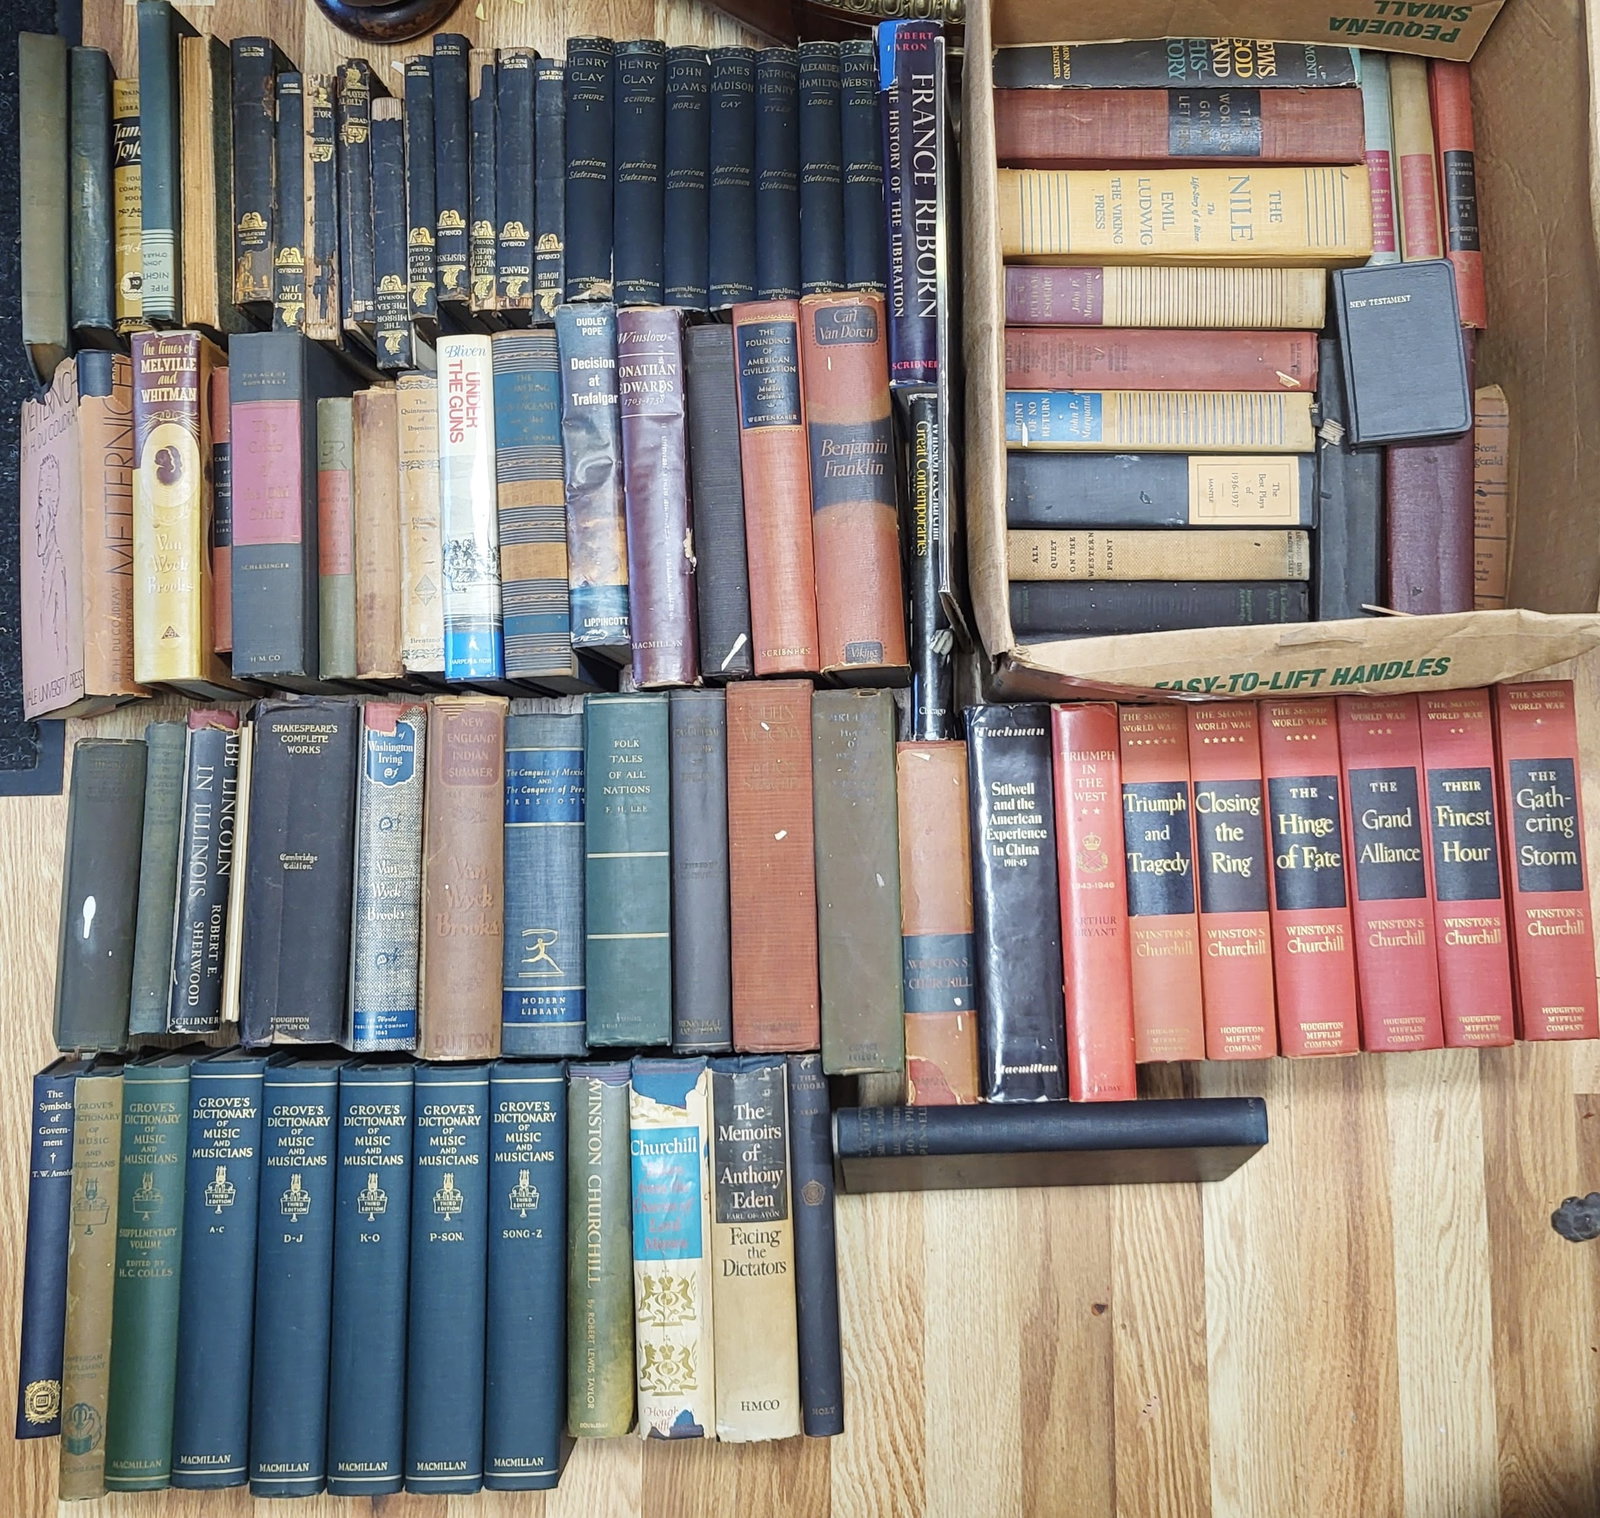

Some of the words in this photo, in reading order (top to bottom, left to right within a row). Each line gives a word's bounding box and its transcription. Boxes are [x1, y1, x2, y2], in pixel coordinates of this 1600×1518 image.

[1374, 0, 1472, 22] SMALL
[1328, 16, 1461, 43] PEQUEÑA
[568, 56, 609, 69] HENRY
[571, 72, 605, 82] CLAY
[670, 67, 702, 79] JOHN
[666, 83, 707, 94] ADAMS
[911, 73, 937, 186] FRANCE
[889, 106, 900, 170] HISTORY
[568, 158, 607, 168] American
[568, 171, 607, 180] Statesmen
[891, 176, 900, 195] OF
[1112, 178, 1122, 200] THE
[891, 200, 901, 228] THE
[1095, 195, 1105, 230] PRESS
[1138, 178, 1153, 246] LUDWIG
[1161, 192, 1175, 231] EMIL
[1229, 175, 1254, 242] NILE
[1269, 191, 1283, 223] THE
[1114, 204, 1124, 245] VIKING
[914, 198, 937, 318] REBORN
[142, 272, 169, 280] NIGHT
[891, 233, 904, 318] LIBERATION
[279, 292, 302, 301] LORD
[1350, 299, 1366, 308] NEW
[1369, 295, 1412, 306] TESTAMENT
[576, 317, 608, 327] DUDLEY
[833, 310, 857, 323] Carl
[582, 327, 603, 336] POPE
[618, 330, 667, 344] Winslow
[819, 327, 838, 340] Van
[840, 326, 874, 339] Doren
[745, 337, 791, 347] FOUNDING
[445, 345, 486, 358] Bliven
[141, 358, 197, 373] MELVILLE
[571, 356, 615, 370] Decision
[747, 356, 790, 366] AMERICAN
[448, 359, 463, 392] THE
[742, 366, 797, 376] CIVILIZATION
[158, 373, 178, 385] and
[589, 375, 600, 387] at
[141, 388, 197, 404] WHITMAN
[465, 371, 478, 428] UNDER
[572, 392, 618, 406] Trafalgar
[449, 396, 464, 443] GUNS
[915, 420, 929, 457] Great
[821, 438, 888, 460] Benjamin
[824, 459, 884, 477] Franklin
[1258, 473, 1266, 487] Best
[1231, 471, 1239, 508] 1936-1937
[1258, 489, 1266, 509] Plays
[915, 459, 928, 557] Contemporaries
[1050, 540, 1058, 569] QUIET
[1069, 558, 1076, 573] ON
[584, 617, 629, 627] LIPPINCOTT
[631, 640, 683, 650] MACMILLAN
[1330, 656, 1451, 686] HANDLES
[272, 724, 338, 733] SHAKESPEARE'S
[1272, 719, 1304, 728] WORLD
[1307, 718, 1328, 726] WAR
[281, 735, 329, 743] COMPLETE
[975, 726, 1045, 738] Tuchman
[223, 731, 240, 768] ABE
[287, 746, 321, 754] WORKS
[368, 741, 414, 752] Washington
[613, 739, 640, 748] FOLK
[378, 753, 403, 765] Irving
[452, 752, 489, 761] INDIAN
[609, 755, 643, 763] TALES
[449, 767, 493, 778] SUMMER
[609, 771, 621, 779] OF
[626, 771, 646, 779] ALL
[1082, 764, 1096, 774] IN
[196, 765, 213, 791] IN
[1528, 772, 1557, 781] THE
[603, 785, 651, 795] NATIONS
[992, 782, 1035, 796] Stilwell
[1076, 779, 1104, 789] THE
[1370, 782, 1397, 792] THE
[1442, 781, 1482, 791] THEIR
[1074, 792, 1107, 801] WEST
[1290, 788, 1318, 798] THE
[1516, 786, 1572, 811] Gath-
[993, 799, 1015, 811] and
[1017, 799, 1035, 809] the
[1123, 792, 1186, 815] Triumph
[1195, 792, 1261, 815] Closing
[989, 814, 1042, 825] American
[1362, 807, 1412, 831] Grand
[1435, 806, 1492, 827] Finest
[216, 777, 236, 877] LINCOLN
[1215, 823, 1244, 842] the
[1279, 814, 1334, 837] Hinge
[1525, 814, 1575, 838] ering
[987, 828, 1047, 842] Experience
[1144, 825, 1170, 841] and
[189, 802, 212, 898] ILLINOIS
[993, 844, 1004, 856] in
[1006, 843, 1040, 856] China
[1360, 843, 1421, 864] Alliance
[1442, 841, 1491, 863] Hour
[1520, 845, 1578, 867] Storm
[1128, 852, 1190, 876] Tragedy
[1277, 845, 1299, 869] of
[1302, 847, 1341, 869] Fate
[1211, 852, 1253, 877] Ring
[1527, 920, 1584, 937] Churchill
[1208, 940, 1266, 957] Churchill
[1287, 936, 1345, 954] Churchill
[187, 921, 205, 1006] SHERWOOD
[522, 997, 566, 1005] MODERN
[1300, 1022, 1344, 1031] HOUGHTON
[1306, 1032, 1341, 1040] MIFFLIN
[1304, 1040, 1343, 1048] COMPANY
[47, 1090, 64, 1099] The
[39, 1102, 72, 1112] Symbols
[198, 1097, 251, 1108] GROVE'S
[50, 1114, 61, 1123] of
[193, 1108, 257, 1119] DICTIONARY
[733, 1104, 765, 1120] The
[587, 1078, 603, 1165] WINSTON
[39, 1126, 71, 1135] Govern-
[203, 1128, 240, 1139] MUSIC
[719, 1125, 782, 1142] Memoirs
[43, 1139, 63, 1147] ment
[631, 1137, 697, 1155] Churchill
[192, 1148, 253, 1159] MUSICIANS
[742, 1144, 762, 1162] of
[720, 1168, 784, 1188] Anthony
[732, 1192, 774, 1209] Eden
[360, 1233, 380, 1243] K-O
[502, 1229, 543, 1239] SONG-Z
[587, 1174, 601, 1288] CHURCHILL
[730, 1226, 782, 1248] Facing
[283, 1233, 303, 1244] D-J
[747, 1246, 767, 1258] the
[723, 1258, 787, 1277] Dictators
[180, 1454, 231, 1465] MACMILLAN
